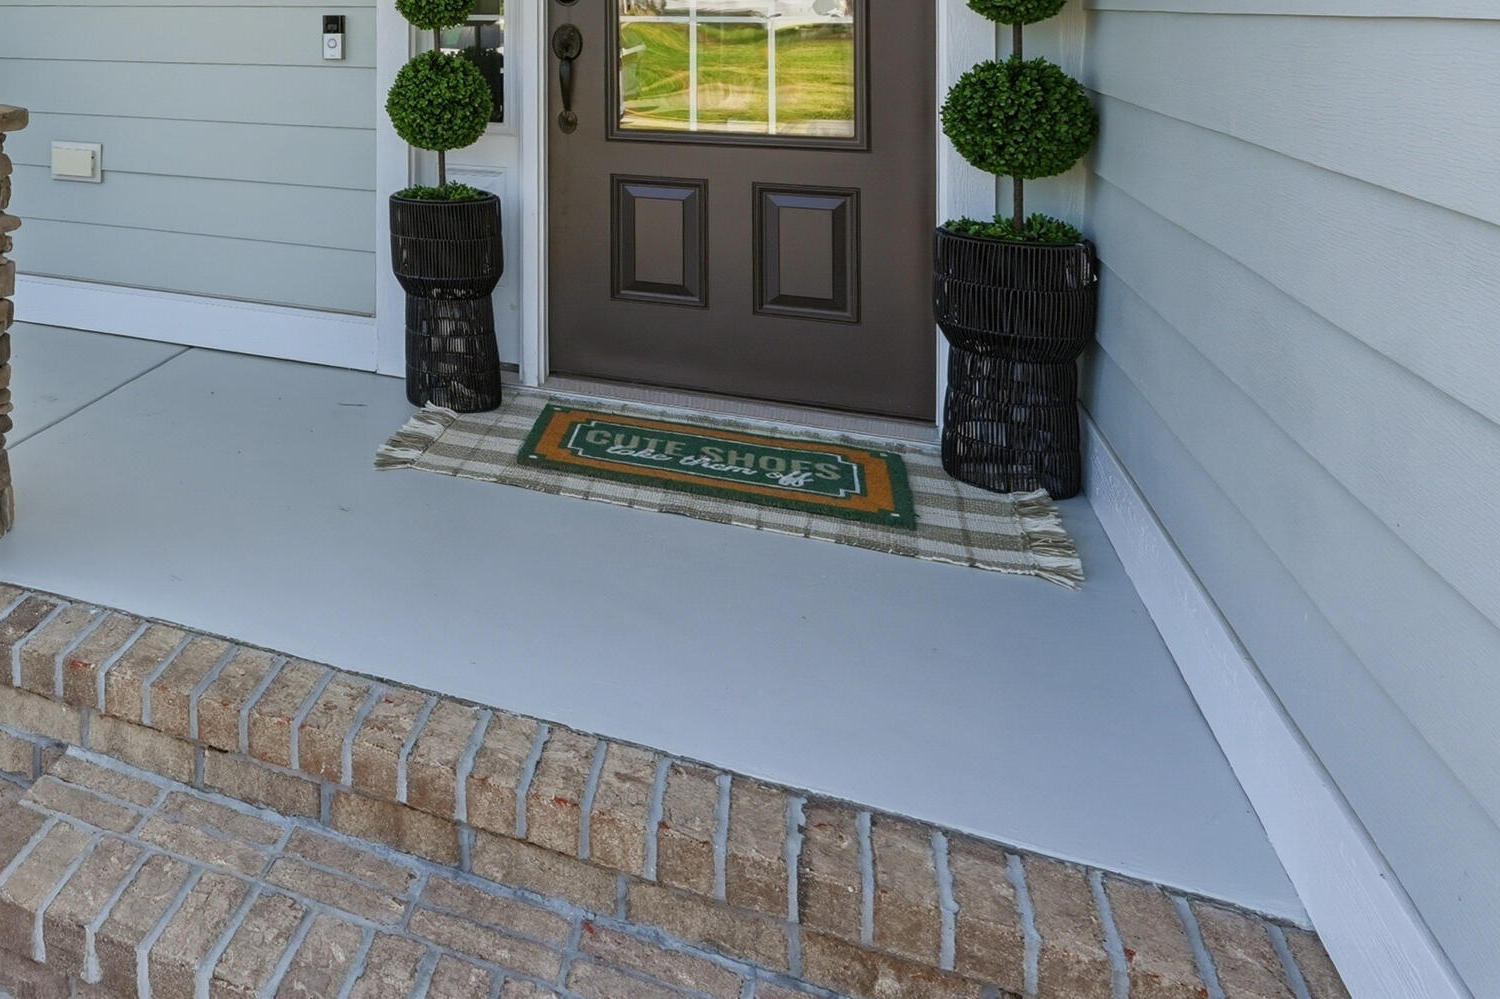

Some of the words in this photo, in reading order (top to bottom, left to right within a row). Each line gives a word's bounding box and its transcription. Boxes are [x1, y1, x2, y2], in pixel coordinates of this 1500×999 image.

[585, 429, 687, 457] CUTE
[700, 446, 842, 481] SHOES
[606, 444, 673, 461] take
[679, 455, 757, 476] them
[765, 470, 815, 487] off
